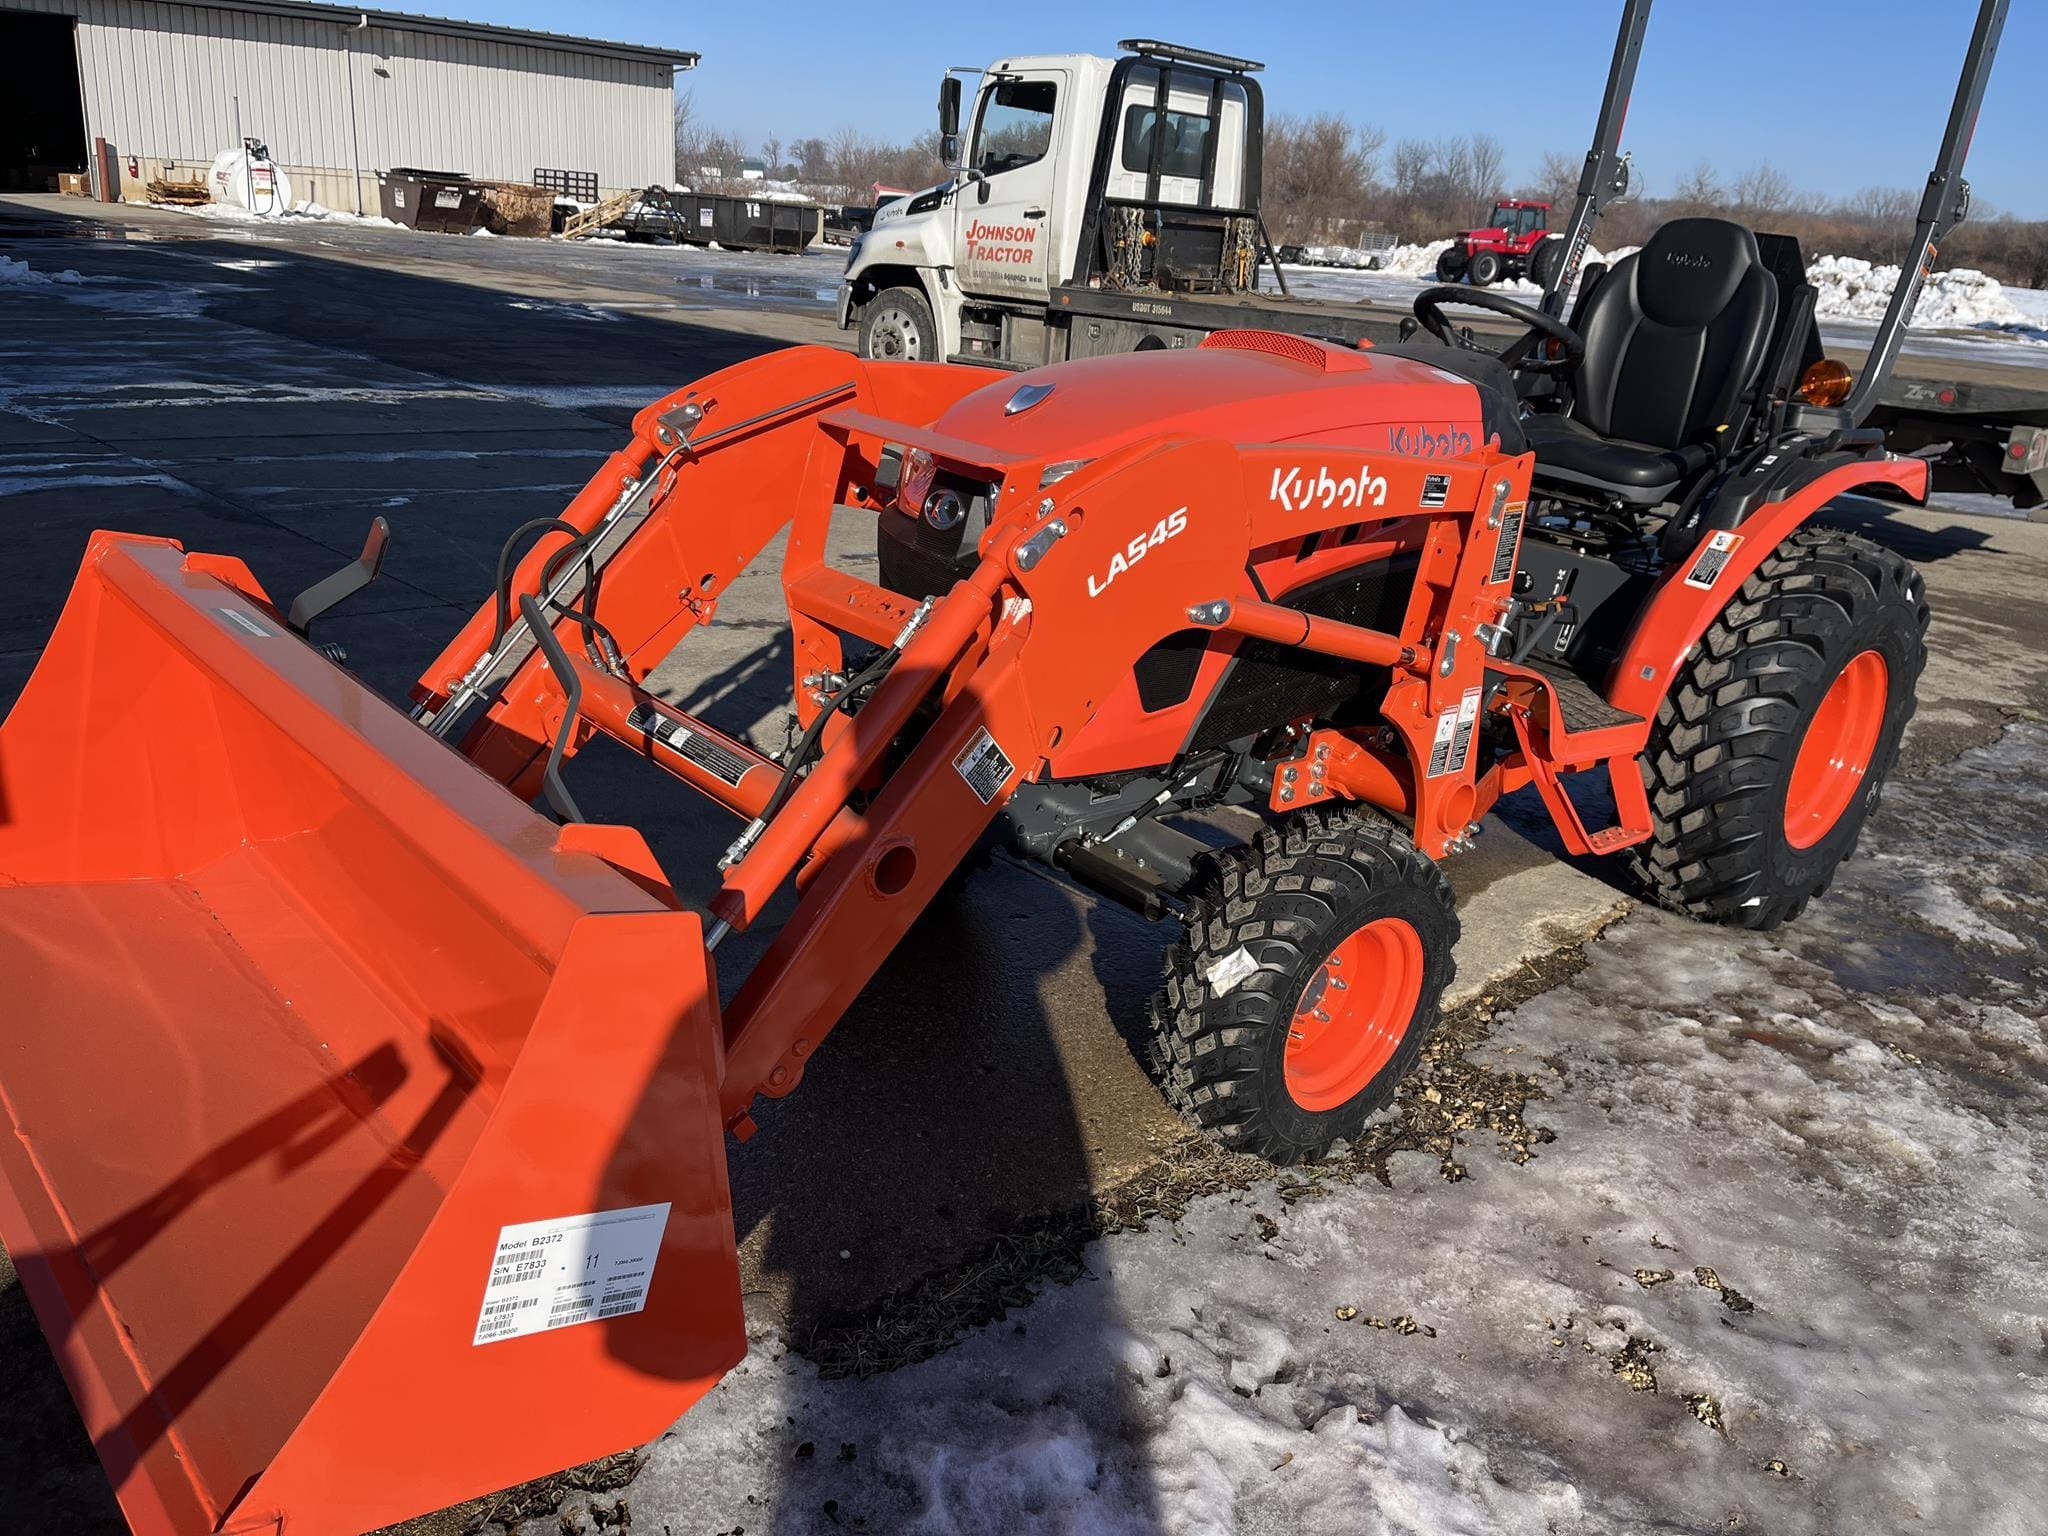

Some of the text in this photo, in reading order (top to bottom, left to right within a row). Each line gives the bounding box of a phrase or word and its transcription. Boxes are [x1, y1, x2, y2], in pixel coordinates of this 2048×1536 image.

[943, 192, 954, 206] 27
[966, 219, 1036, 242] JOHNSON
[966, 240, 1033, 264] TRACTOR
[1132, 302, 1151, 313] USDOT
[1388, 424, 1472, 457] Kubota
[1270, 465, 1387, 512] Kubota
[1087, 506, 1188, 599] LA545
[500, 1234, 563, 1251] Model B2372
[494, 1259, 547, 1276] S/N E7833
